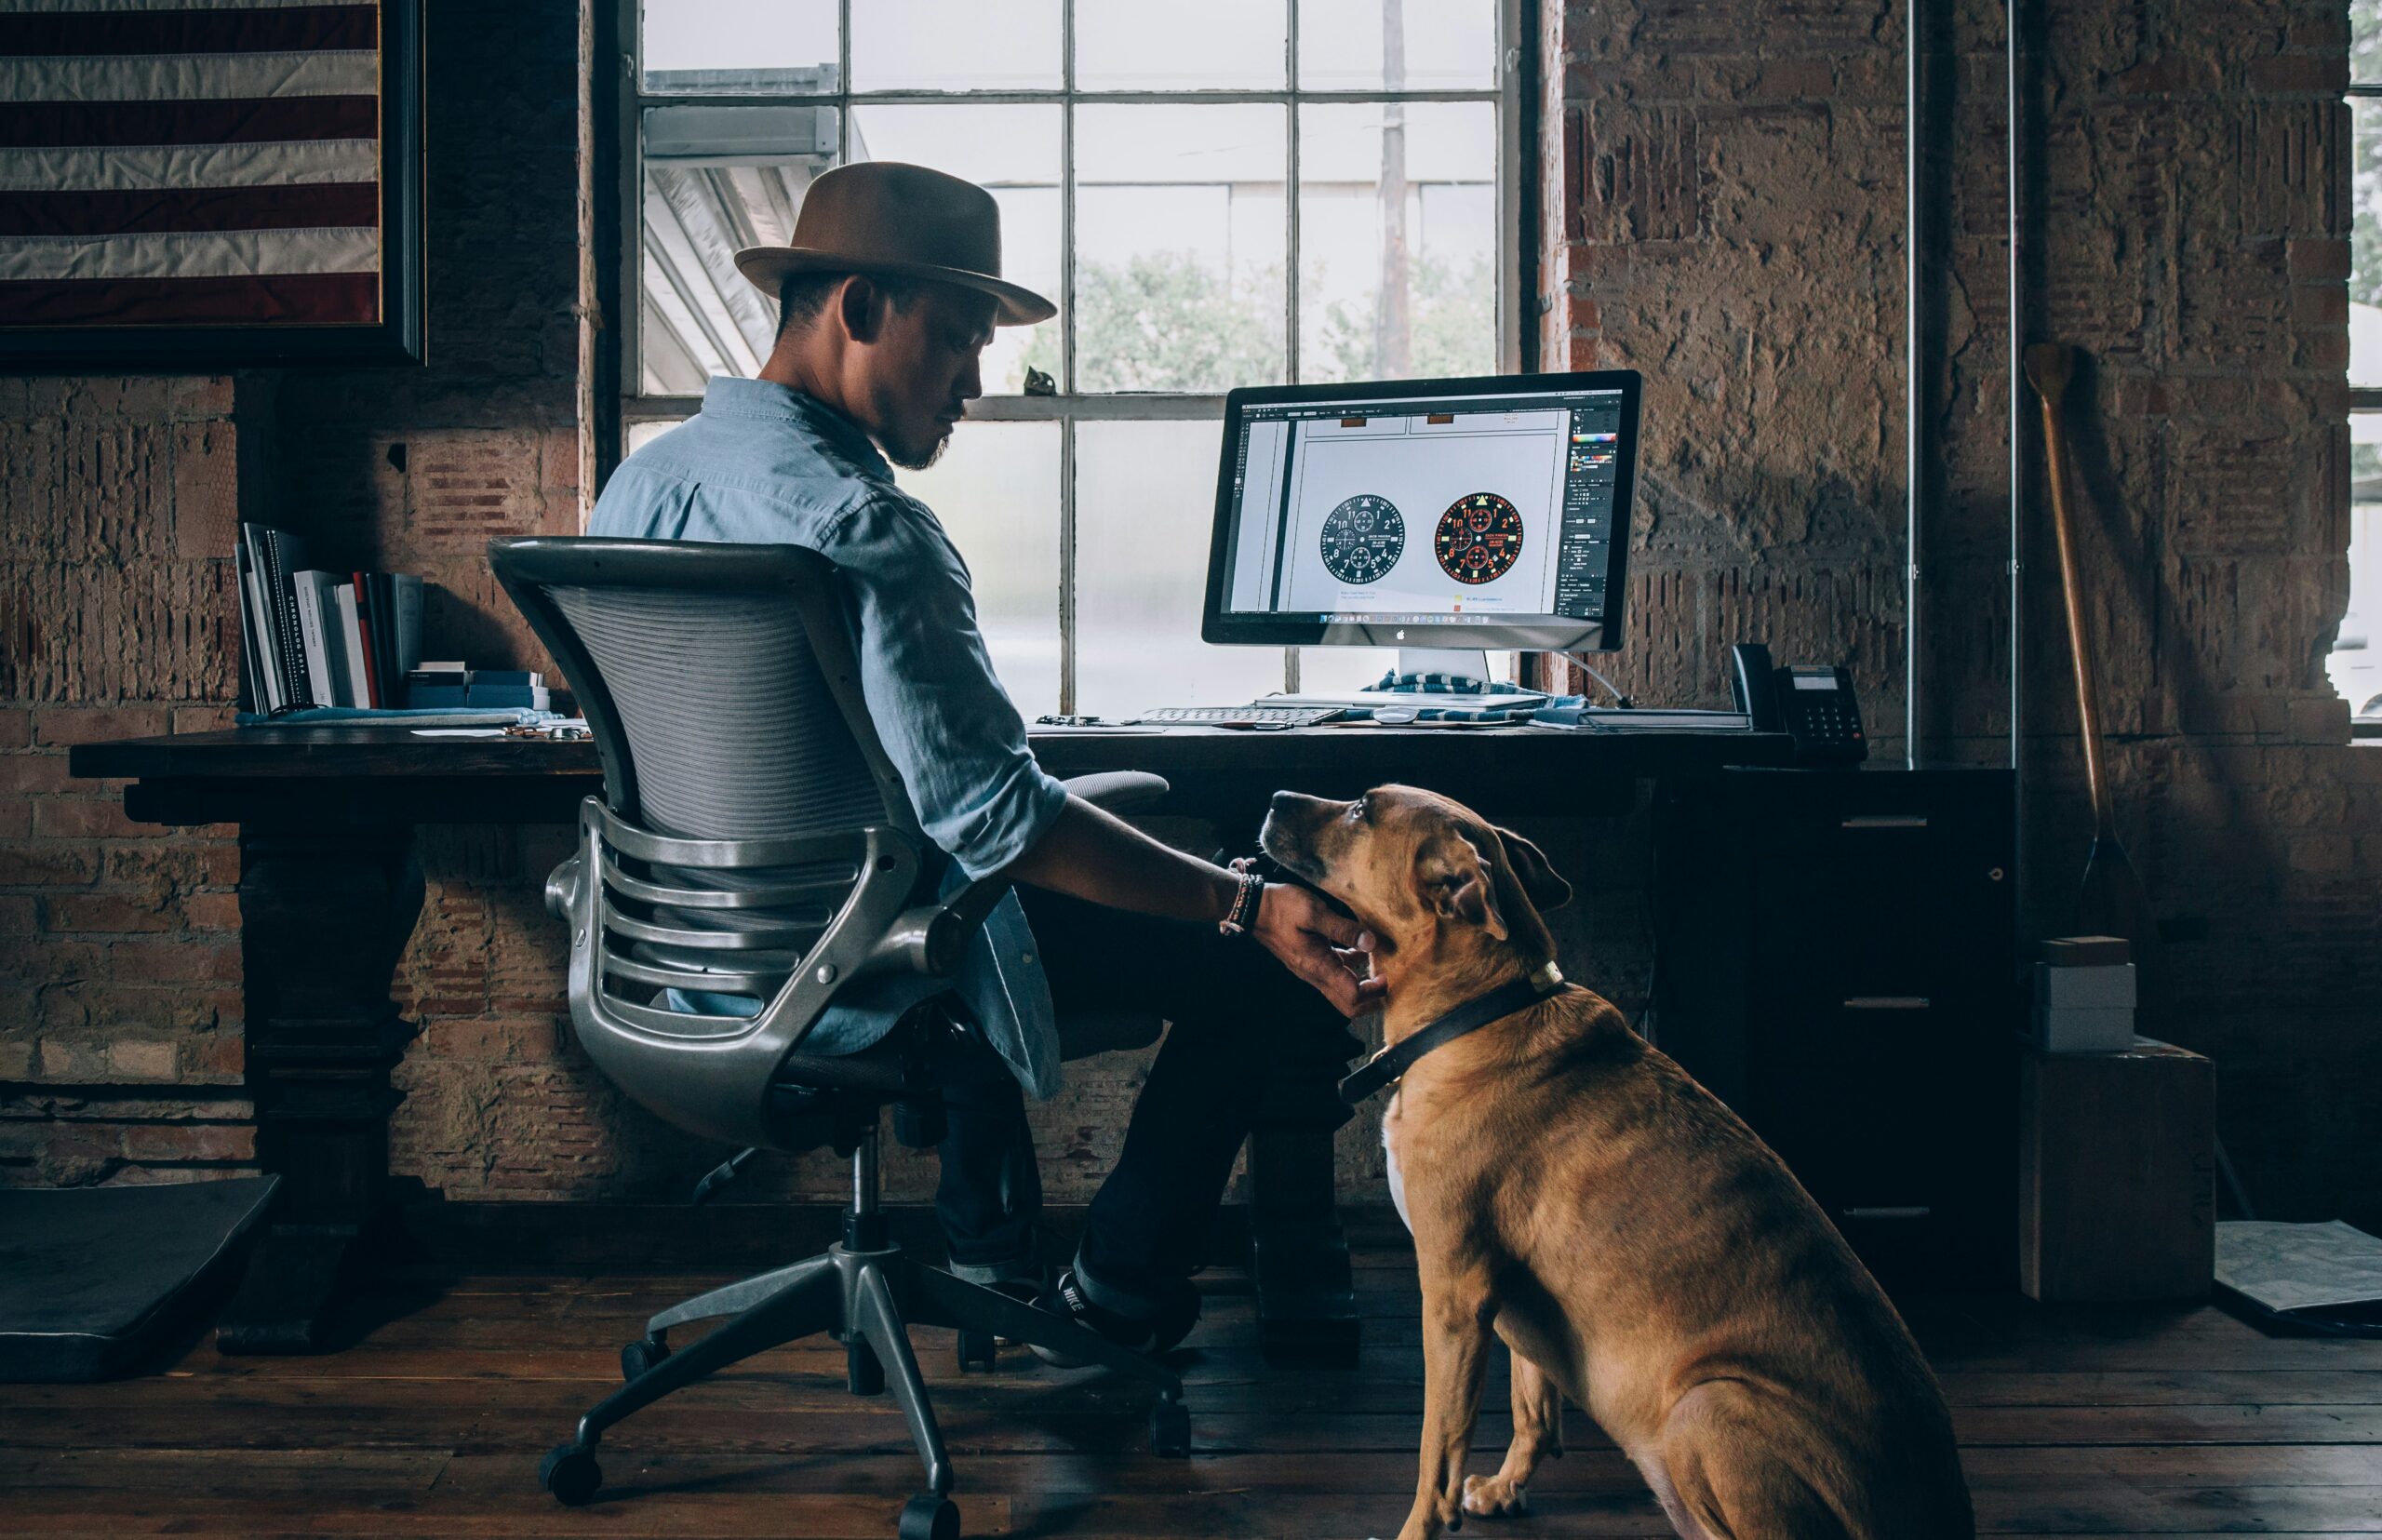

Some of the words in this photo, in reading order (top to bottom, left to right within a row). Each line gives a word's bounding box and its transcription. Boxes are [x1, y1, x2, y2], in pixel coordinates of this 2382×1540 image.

[1348, 511, 1356, 520] 11
[1376, 511, 1381, 519] 1
[1464, 509, 1471, 518] 11
[1493, 508, 1497, 518] 1
[1338, 521, 1347, 529] 10
[1384, 520, 1390, 529] 2
[1452, 519, 1463, 529] 10
[1502, 518, 1508, 529] 2
[1333, 549, 1340, 558] 8
[1381, 548, 1387, 557] 4
[1449, 548, 1455, 557] 8
[1499, 547, 1505, 557] 4
[1344, 559, 1350, 569] 7
[1371, 559, 1376, 569] 5
[1459, 559, 1465, 569] 7
[1488, 558, 1493, 569] 5
[289, 596, 301, 649] CHRONOLOG
[1064, 1287, 1085, 1312] NIKE
